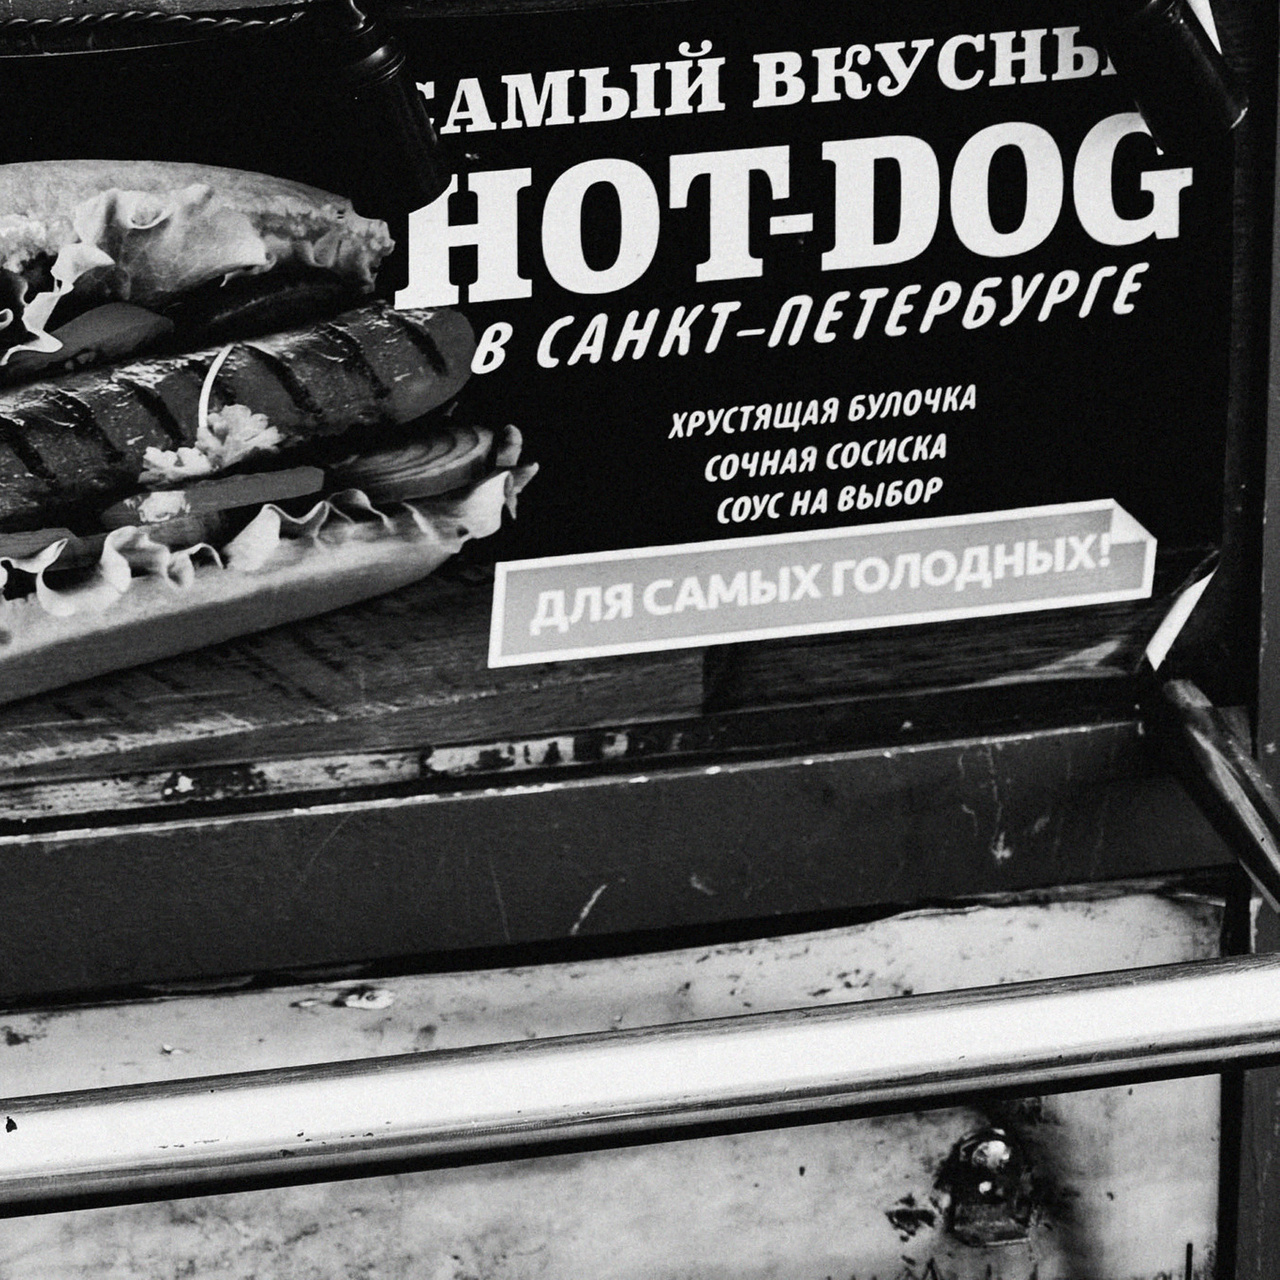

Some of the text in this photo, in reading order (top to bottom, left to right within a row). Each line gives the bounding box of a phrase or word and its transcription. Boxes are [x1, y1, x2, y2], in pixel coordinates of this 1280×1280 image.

[752, 26, 1118, 109] ВКУСНЫ
[393, 111, 1194, 311] HOT-DOG
[470, 261, 1150, 375] В САНКТ-ПЕТЕРБУРГЕ
[667, 383, 977, 440] ХРУСТЯЩАЯ БУЛОЧКА
[704, 433, 947, 483] СОЧНАЯ СОСИСКА
[716, 476, 944, 524] СОУС НА ВЫБОР
[529, 532, 1113, 635] ДЛЯ САМЫХ ГОЛОДНЫХ!
